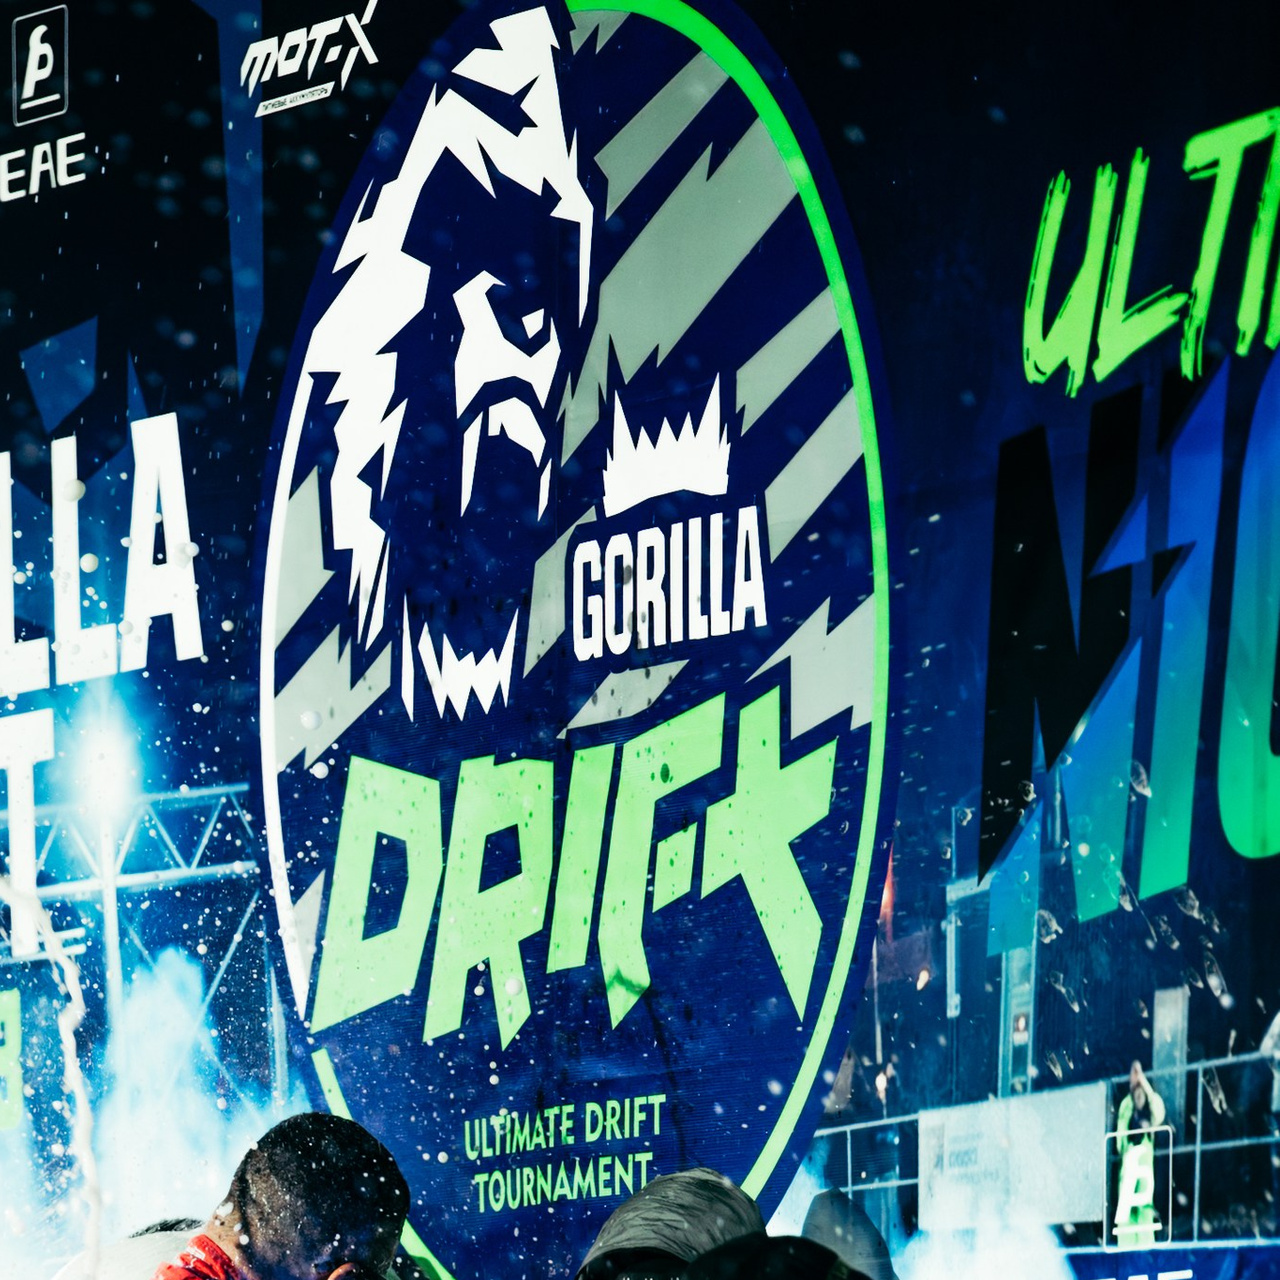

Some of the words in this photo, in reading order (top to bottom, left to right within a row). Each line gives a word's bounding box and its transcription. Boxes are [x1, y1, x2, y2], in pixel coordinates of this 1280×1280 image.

[573, 505, 767, 661] GORILLA
[310, 686, 838, 1051] DRIFT
[464, 1104, 575, 1160] ULTIMATE
[585, 1094, 666, 1142] DRIFT
[474, 1152, 653, 1213] TOURNAMENT
